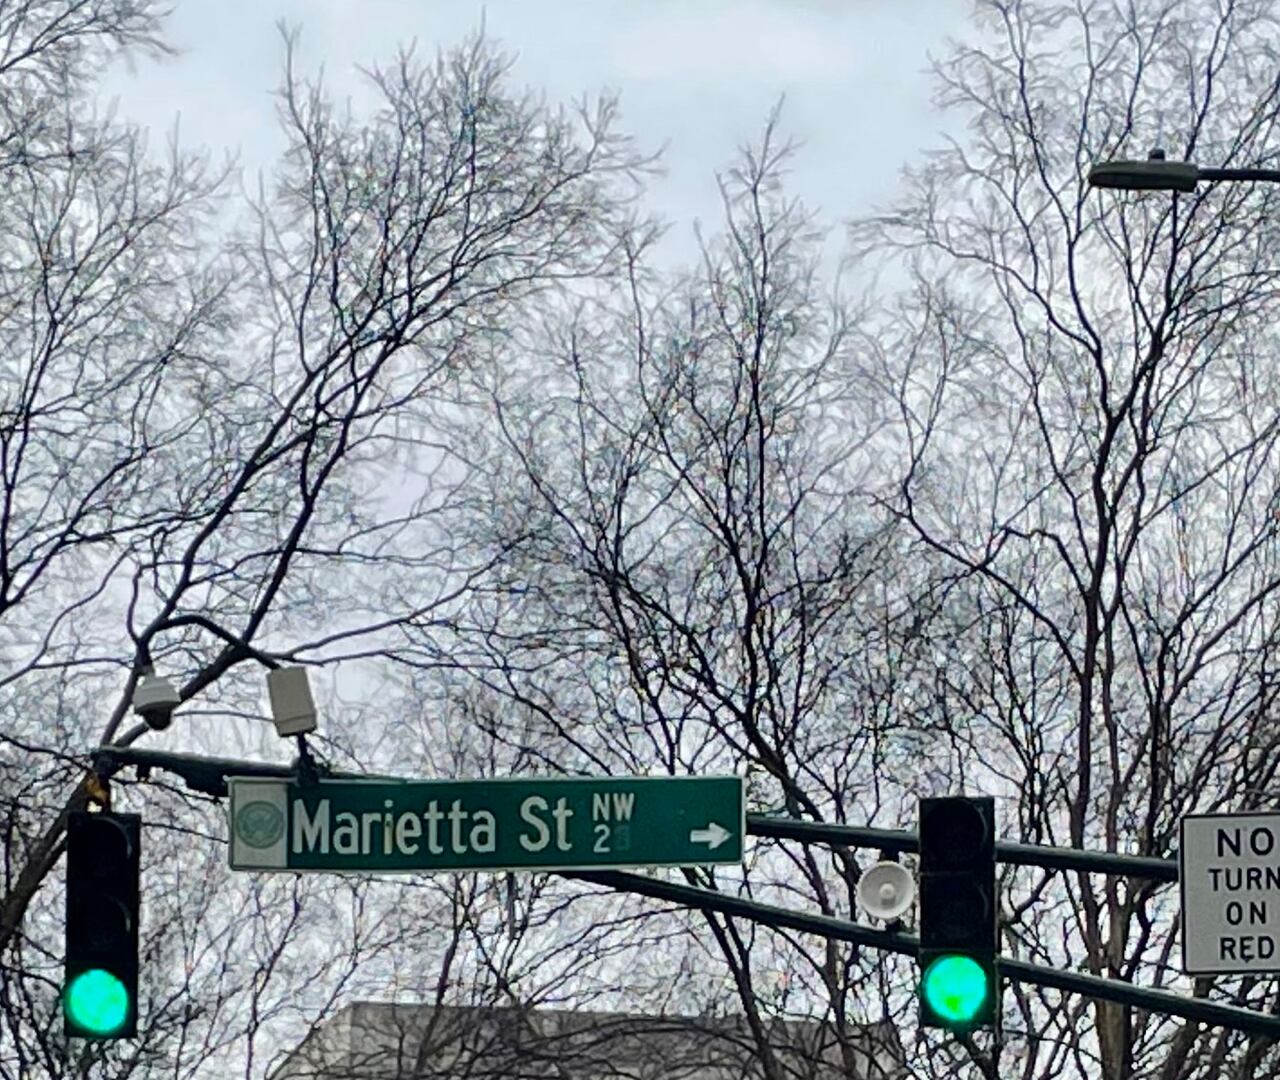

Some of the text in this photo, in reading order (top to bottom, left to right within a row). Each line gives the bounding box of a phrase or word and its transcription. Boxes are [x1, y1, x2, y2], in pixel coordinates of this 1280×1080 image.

[292, 792, 635, 855] Marietta St NW
[1217, 827, 1274, 857] NO
[1226, 901, 1266, 925] ON
[1220, 936, 1274, 960] RED
